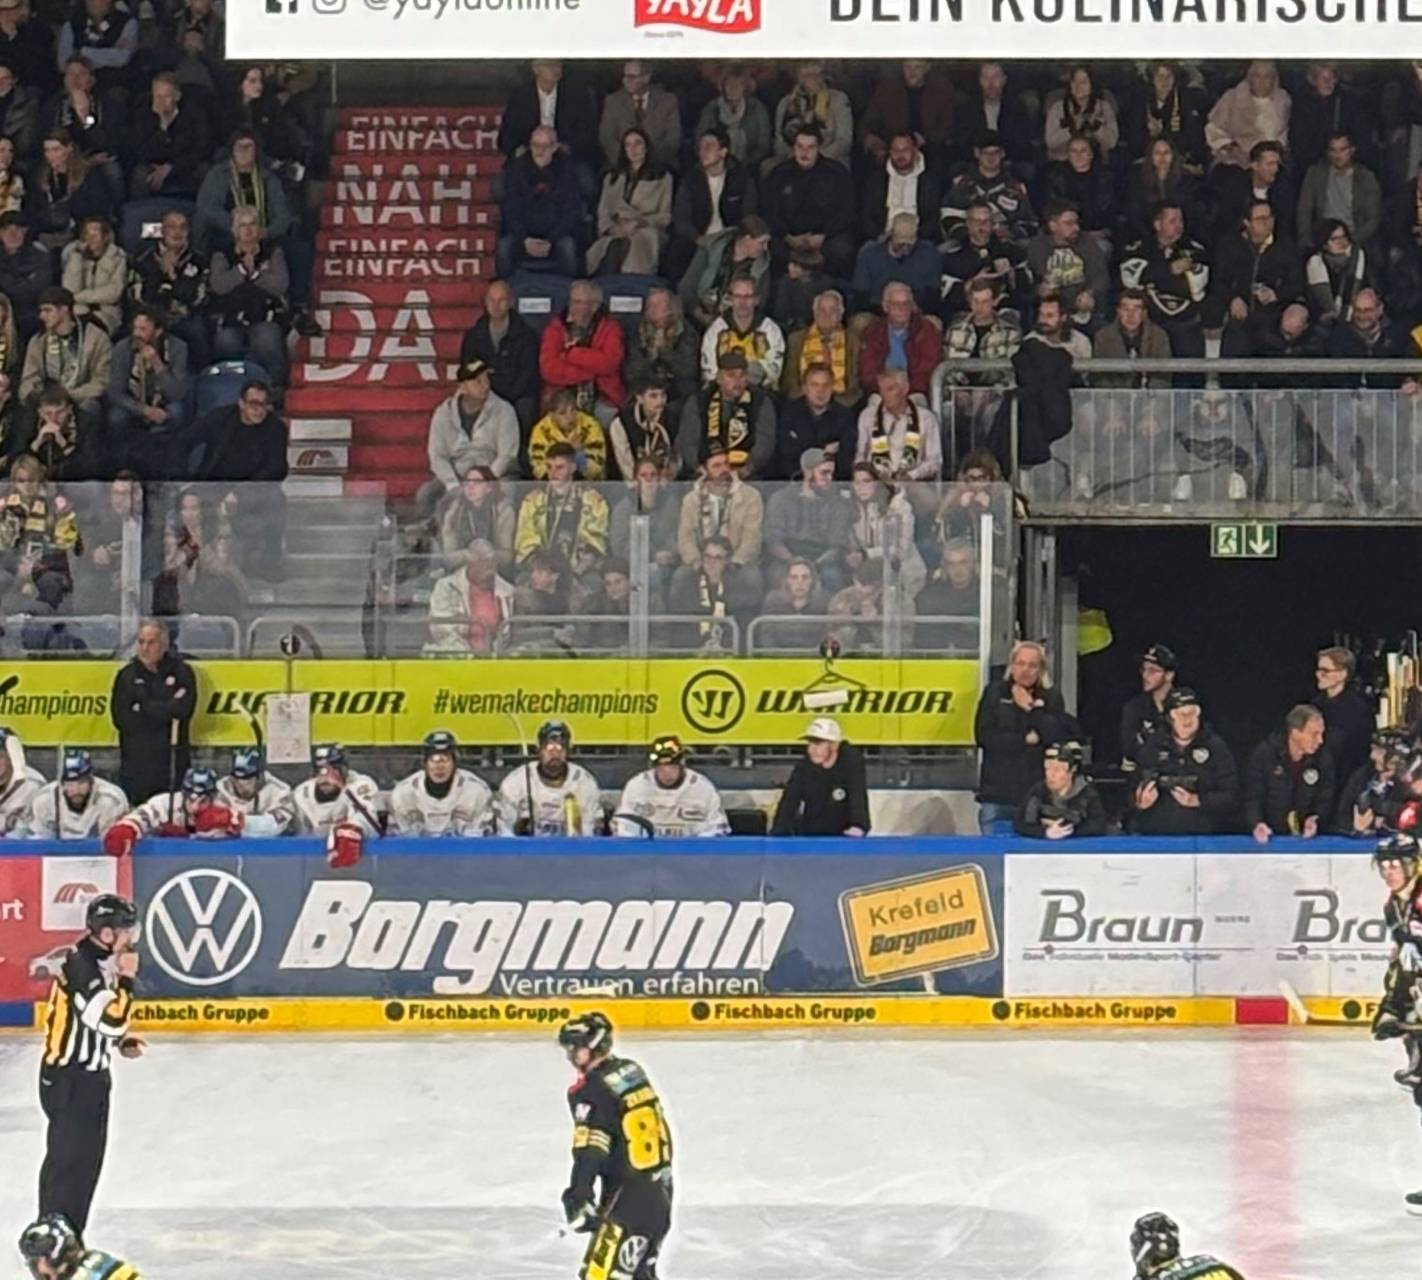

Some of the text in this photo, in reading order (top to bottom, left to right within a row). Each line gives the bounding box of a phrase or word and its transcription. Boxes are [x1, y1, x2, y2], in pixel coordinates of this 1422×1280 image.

[347, 116, 502, 150] EINFACH
[333, 163, 488, 224] NAH.
[324, 239, 485, 276] EINFACH
[206, 691, 406, 714] WARIOR
[433, 687, 660, 718] #wemakechampions
[755, 690, 953, 713] WRIOR
[869, 889, 965, 927] Krefeld
[1038, 889, 1205, 943] Braun
[1292, 889, 1391, 943] Bra
[279, 880, 795, 994] Borgmann
[868, 918, 977, 956] Borgmann
[500, 973, 634, 996] Vertrauen
[131, 1004, 270, 1024] chbach Gruppe
[408, 1004, 571, 1024] Fischbach Gruppe
[714, 1003, 877, 1022] Fischbach Gruppe
[1014, 1002, 1176, 1021] Fischbach Gruppe
